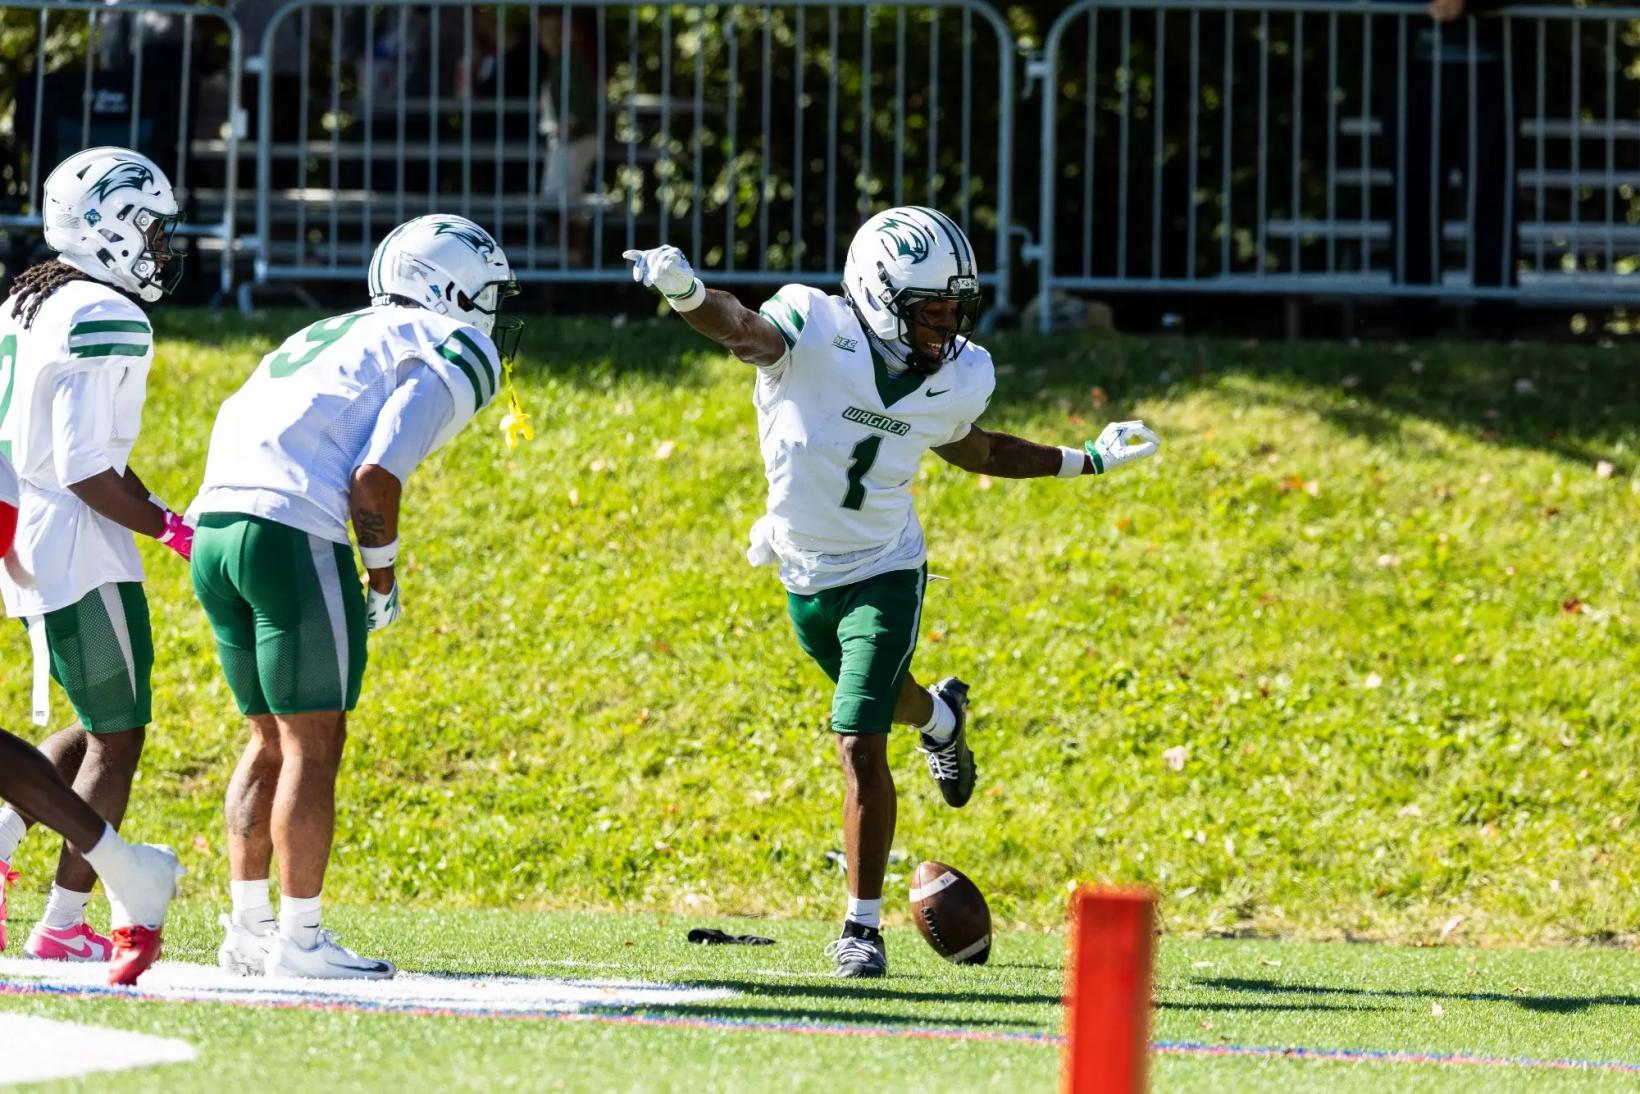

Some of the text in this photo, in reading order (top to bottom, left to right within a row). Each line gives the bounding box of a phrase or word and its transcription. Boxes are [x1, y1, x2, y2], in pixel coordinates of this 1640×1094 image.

[269, 312, 372, 379] 9
[842, 406, 911, 436] WAGNER
[841, 433, 884, 511] 1
